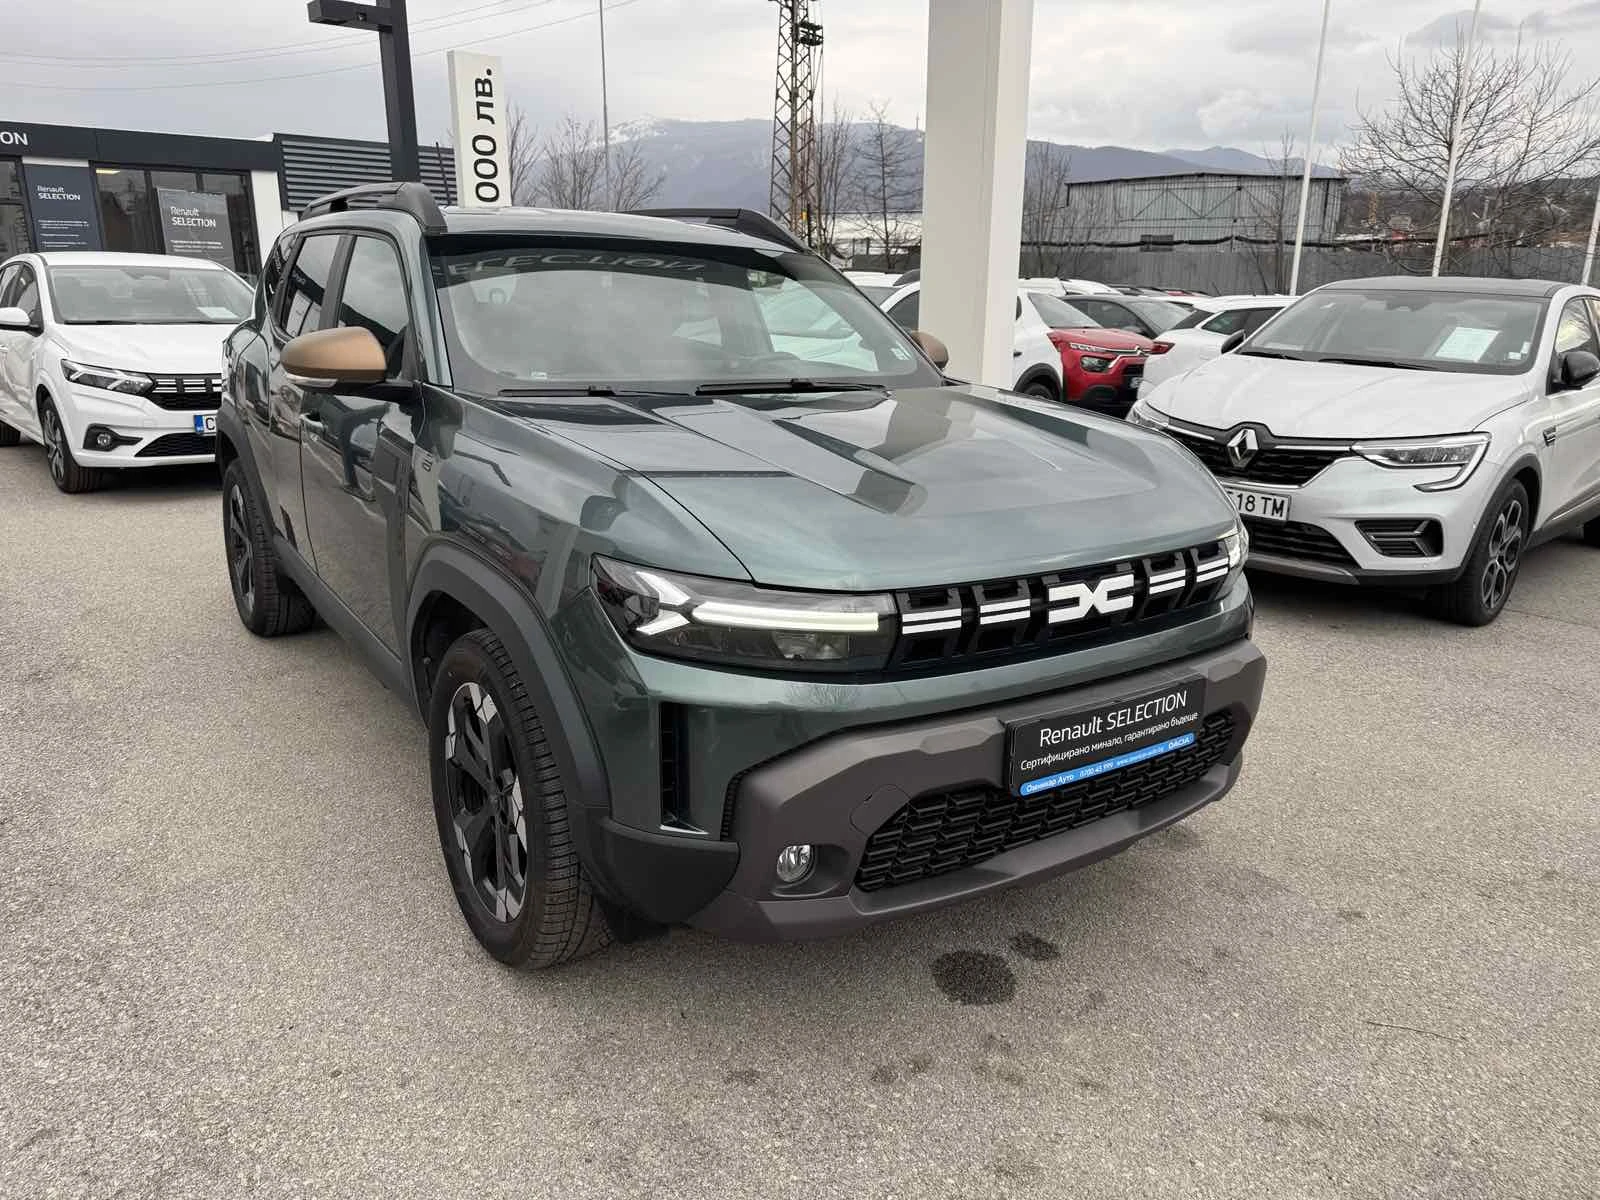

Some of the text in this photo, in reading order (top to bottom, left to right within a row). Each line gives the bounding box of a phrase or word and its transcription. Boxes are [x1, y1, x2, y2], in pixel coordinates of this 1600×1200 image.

[37, 192, 81, 201] SELECTION
[171, 216, 217, 228] SELECTION
[1228, 491, 1285, 518] 18 TM
[1039, 690, 1188, 747] Renault SELECTION
[1020, 744, 1090, 771] Сертифицирано
[1091, 735, 1123, 751] минало,
